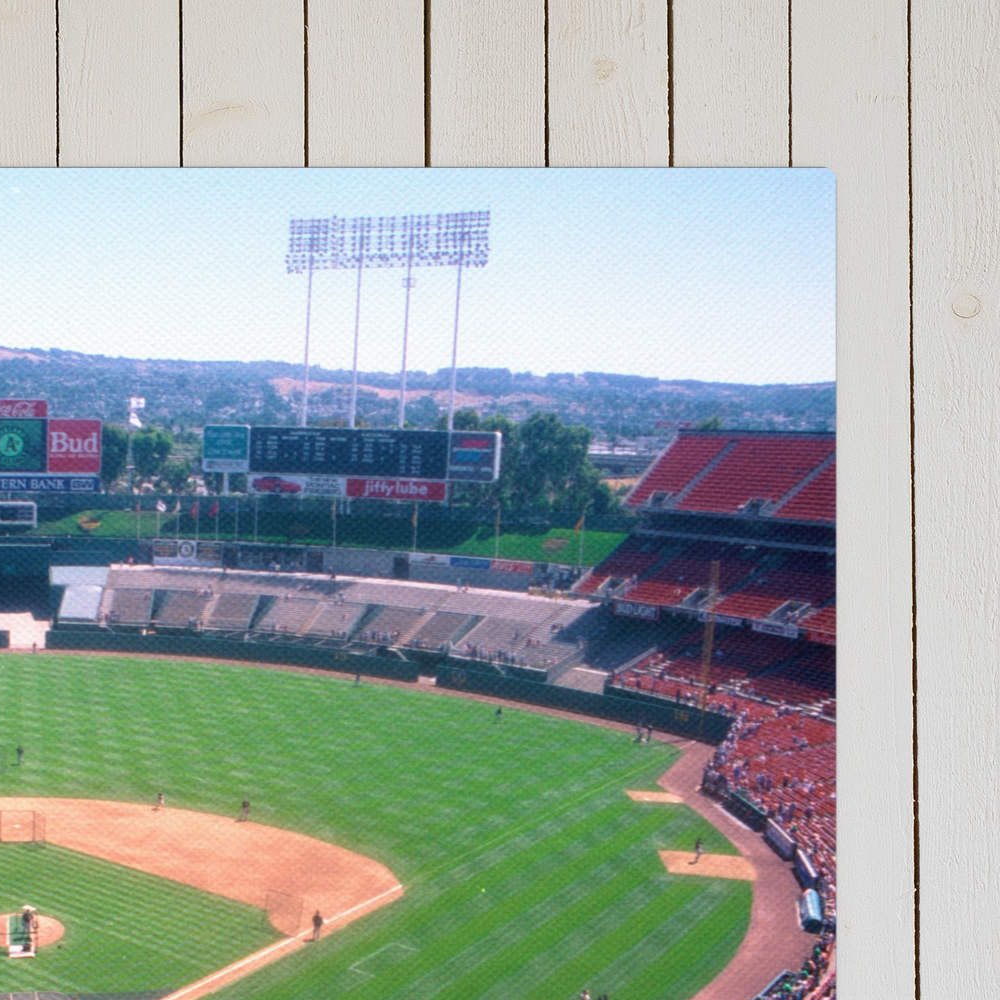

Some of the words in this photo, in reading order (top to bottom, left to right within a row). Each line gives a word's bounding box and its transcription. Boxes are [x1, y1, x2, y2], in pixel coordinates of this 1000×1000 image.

[50, 431, 99, 453] Bud
[30, 479, 66, 490] BANK
[363, 480, 394, 496] jiffy
[395, 482, 428, 496] lube
[492, 561, 514, 572] AVIS
[616, 602, 633, 615] BUD
[633, 604, 657, 618] LIGHT
